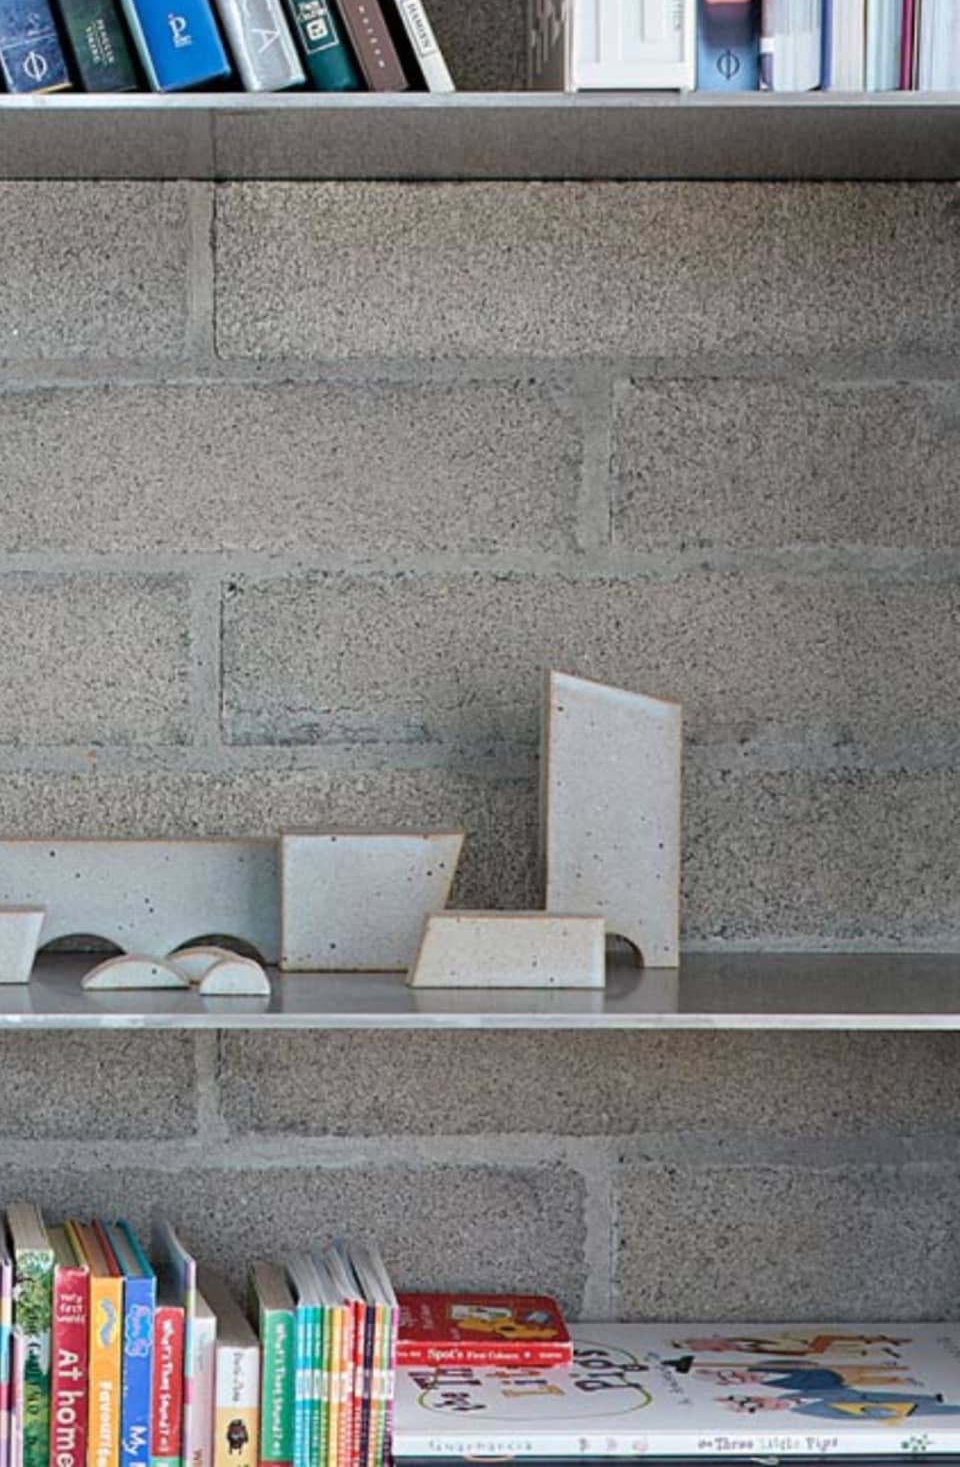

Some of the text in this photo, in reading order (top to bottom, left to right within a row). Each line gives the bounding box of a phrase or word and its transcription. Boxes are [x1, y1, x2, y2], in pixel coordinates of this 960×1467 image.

[427, 1348, 463, 1362] Spot's
[56, 1348, 85, 1467] At home
[121, 1425, 147, 1457] My
